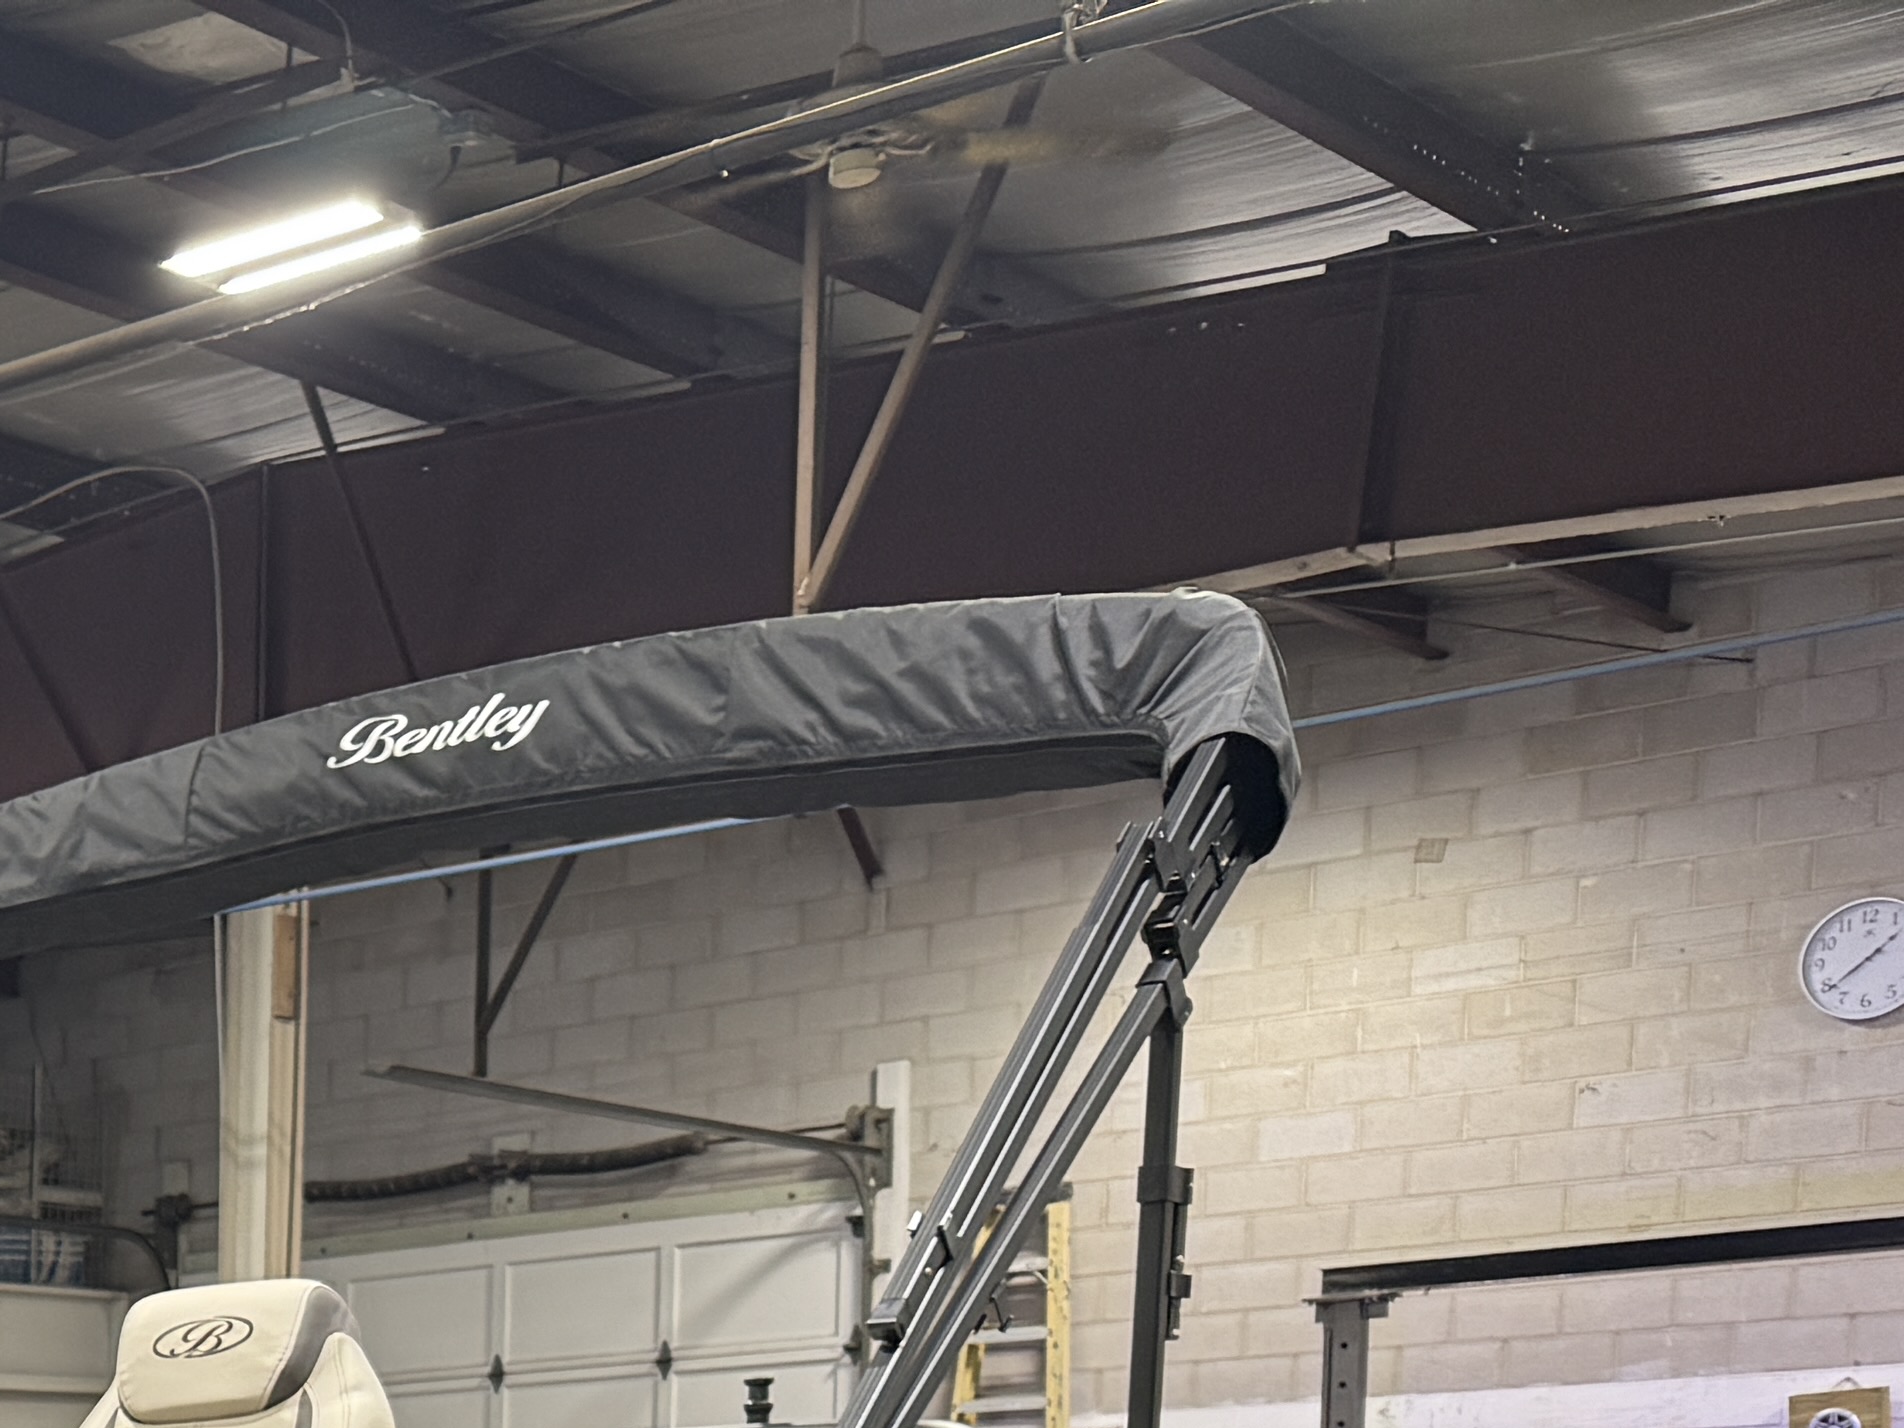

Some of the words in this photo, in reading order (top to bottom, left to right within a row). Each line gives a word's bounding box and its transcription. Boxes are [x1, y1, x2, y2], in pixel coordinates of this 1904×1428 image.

[326, 692, 551, 769] Bentley
[1862, 908, 1880, 924] 12
[1838, 917, 1852, 933] 11
[1820, 935, 1837, 951] 10
[1814, 957, 1826, 971] 9
[1838, 991, 1850, 1005] 7
[1860, 993, 1872, 1008] 6
[164, 1318, 238, 1358] B
